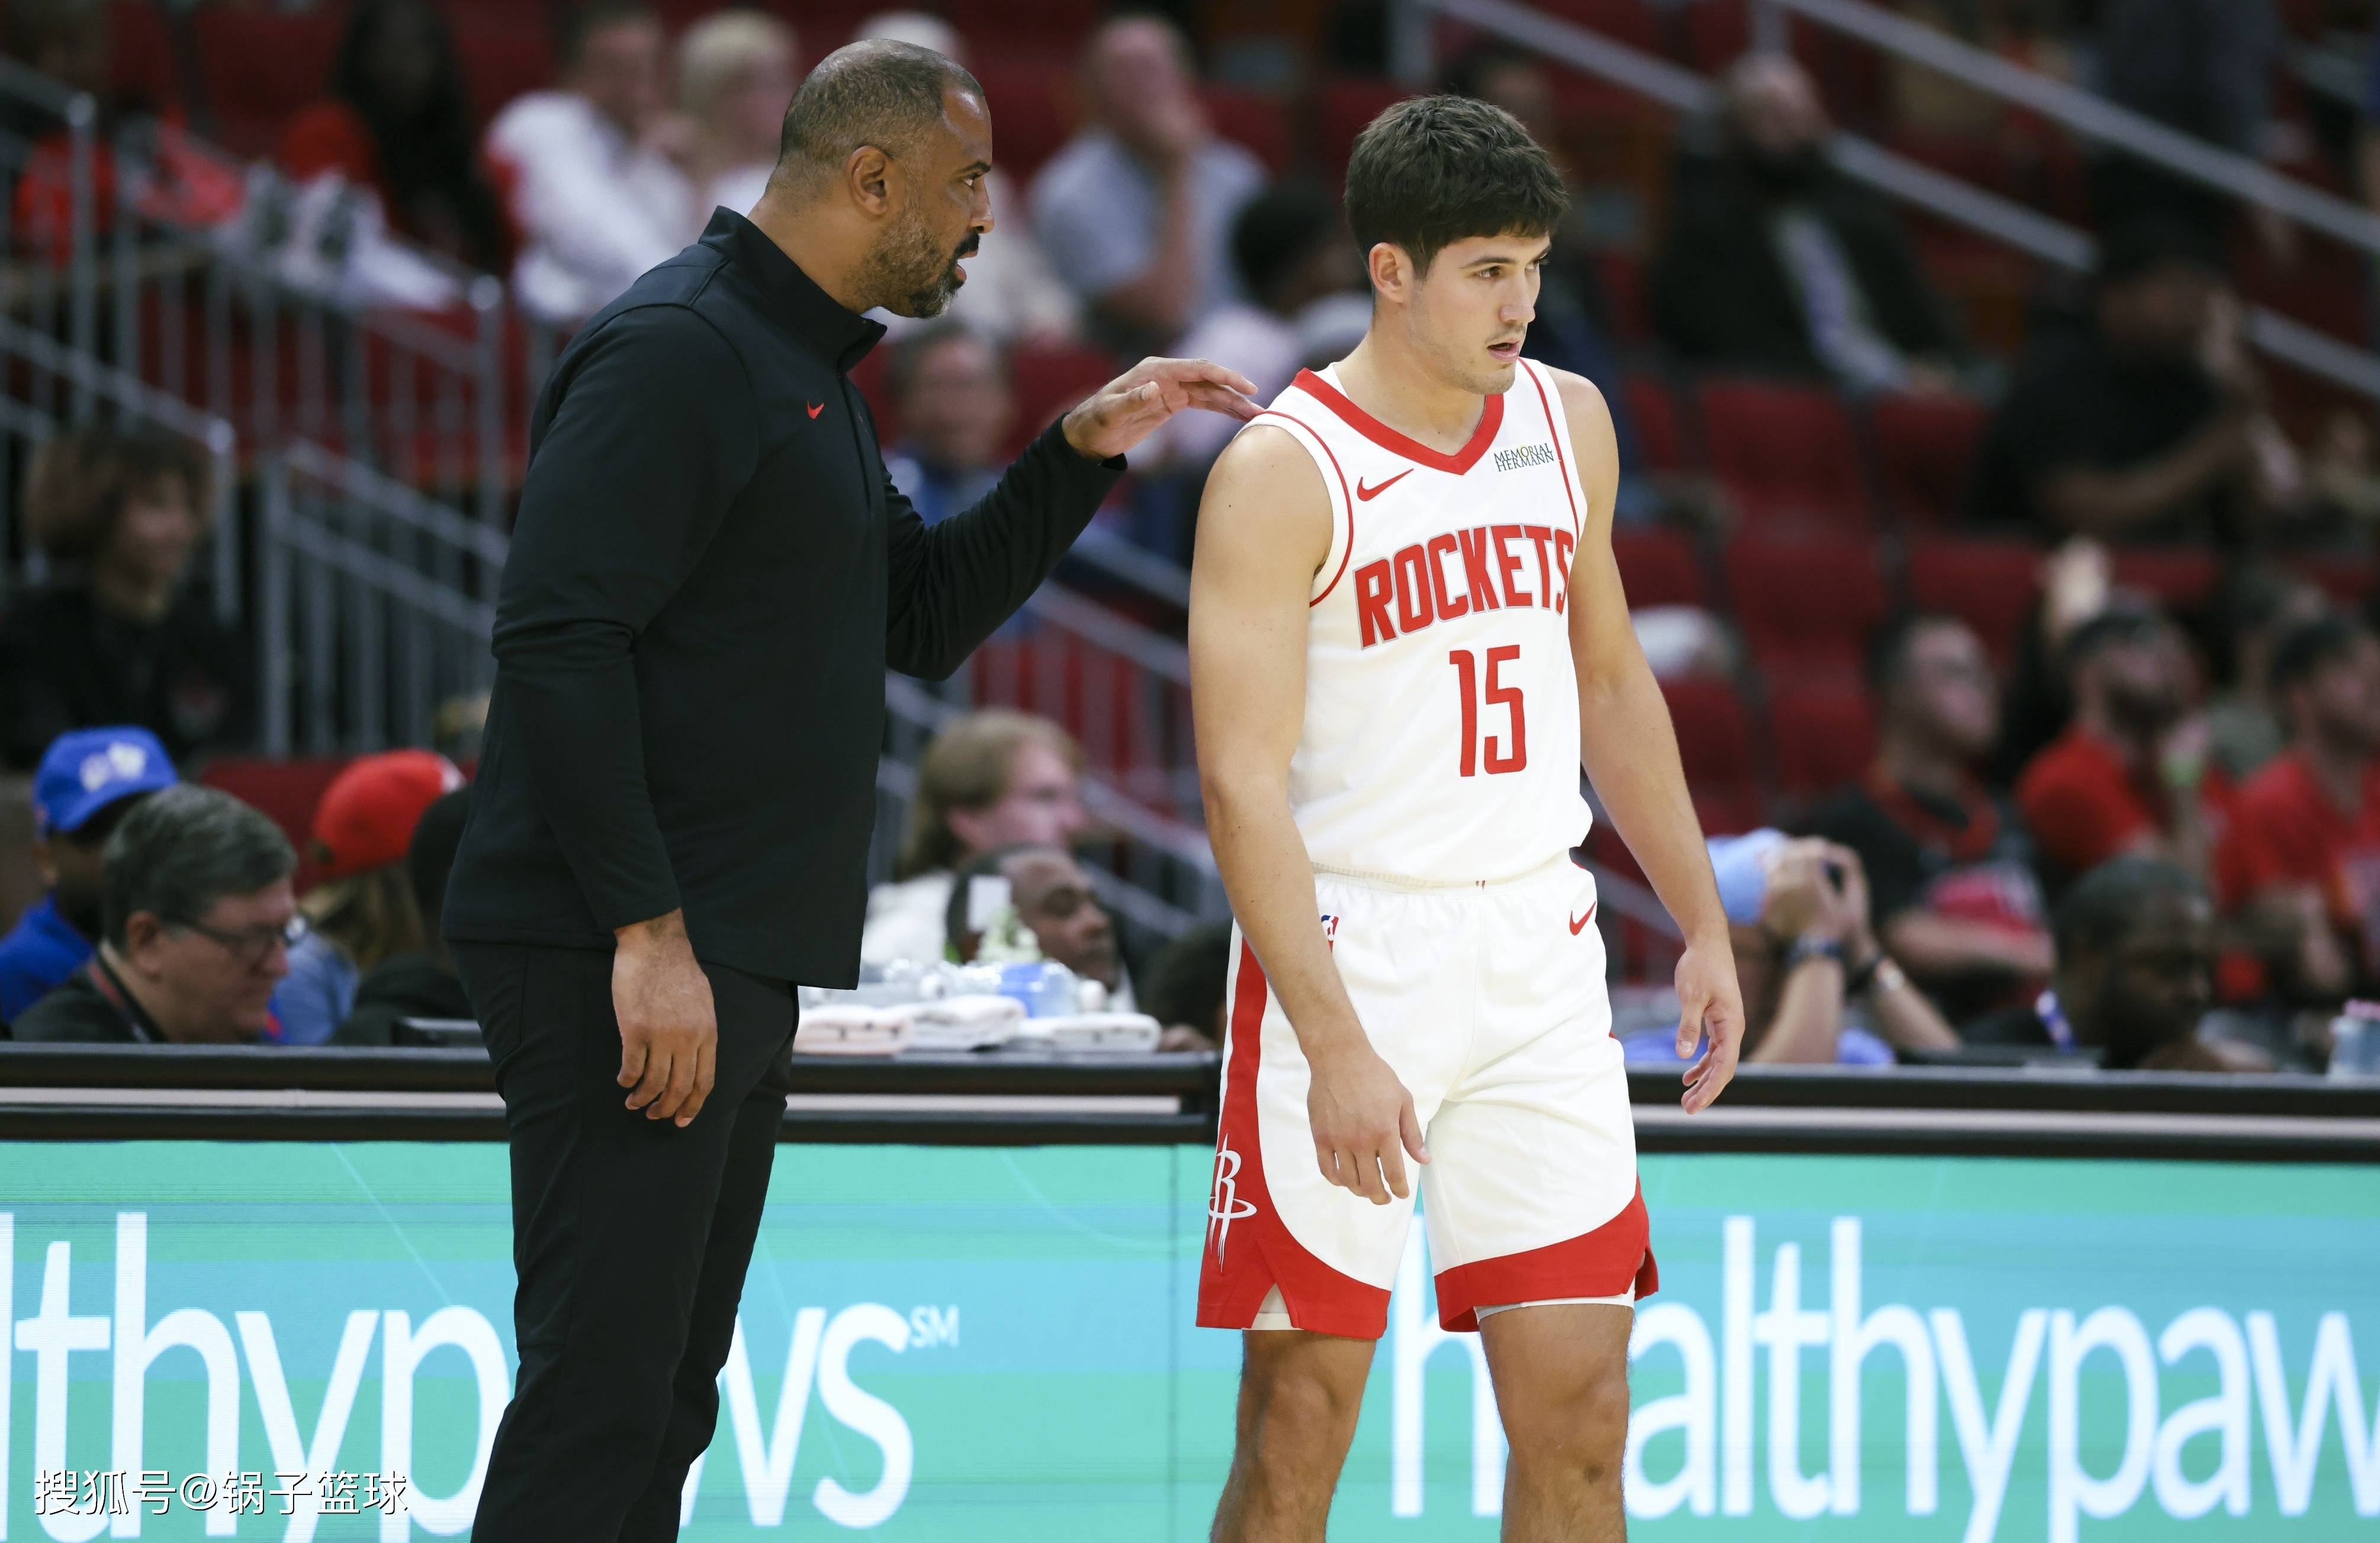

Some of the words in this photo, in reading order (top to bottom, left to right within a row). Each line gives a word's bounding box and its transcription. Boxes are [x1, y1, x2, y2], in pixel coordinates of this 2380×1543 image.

[1494, 443, 1552, 463] MEMORIAL
[1496, 451, 1554, 472] HERMANN
[1353, 523, 1577, 650] ROCKETS
[1449, 645, 1527, 777] 15
[1390, 1215, 2380, 1543] halthypaw
